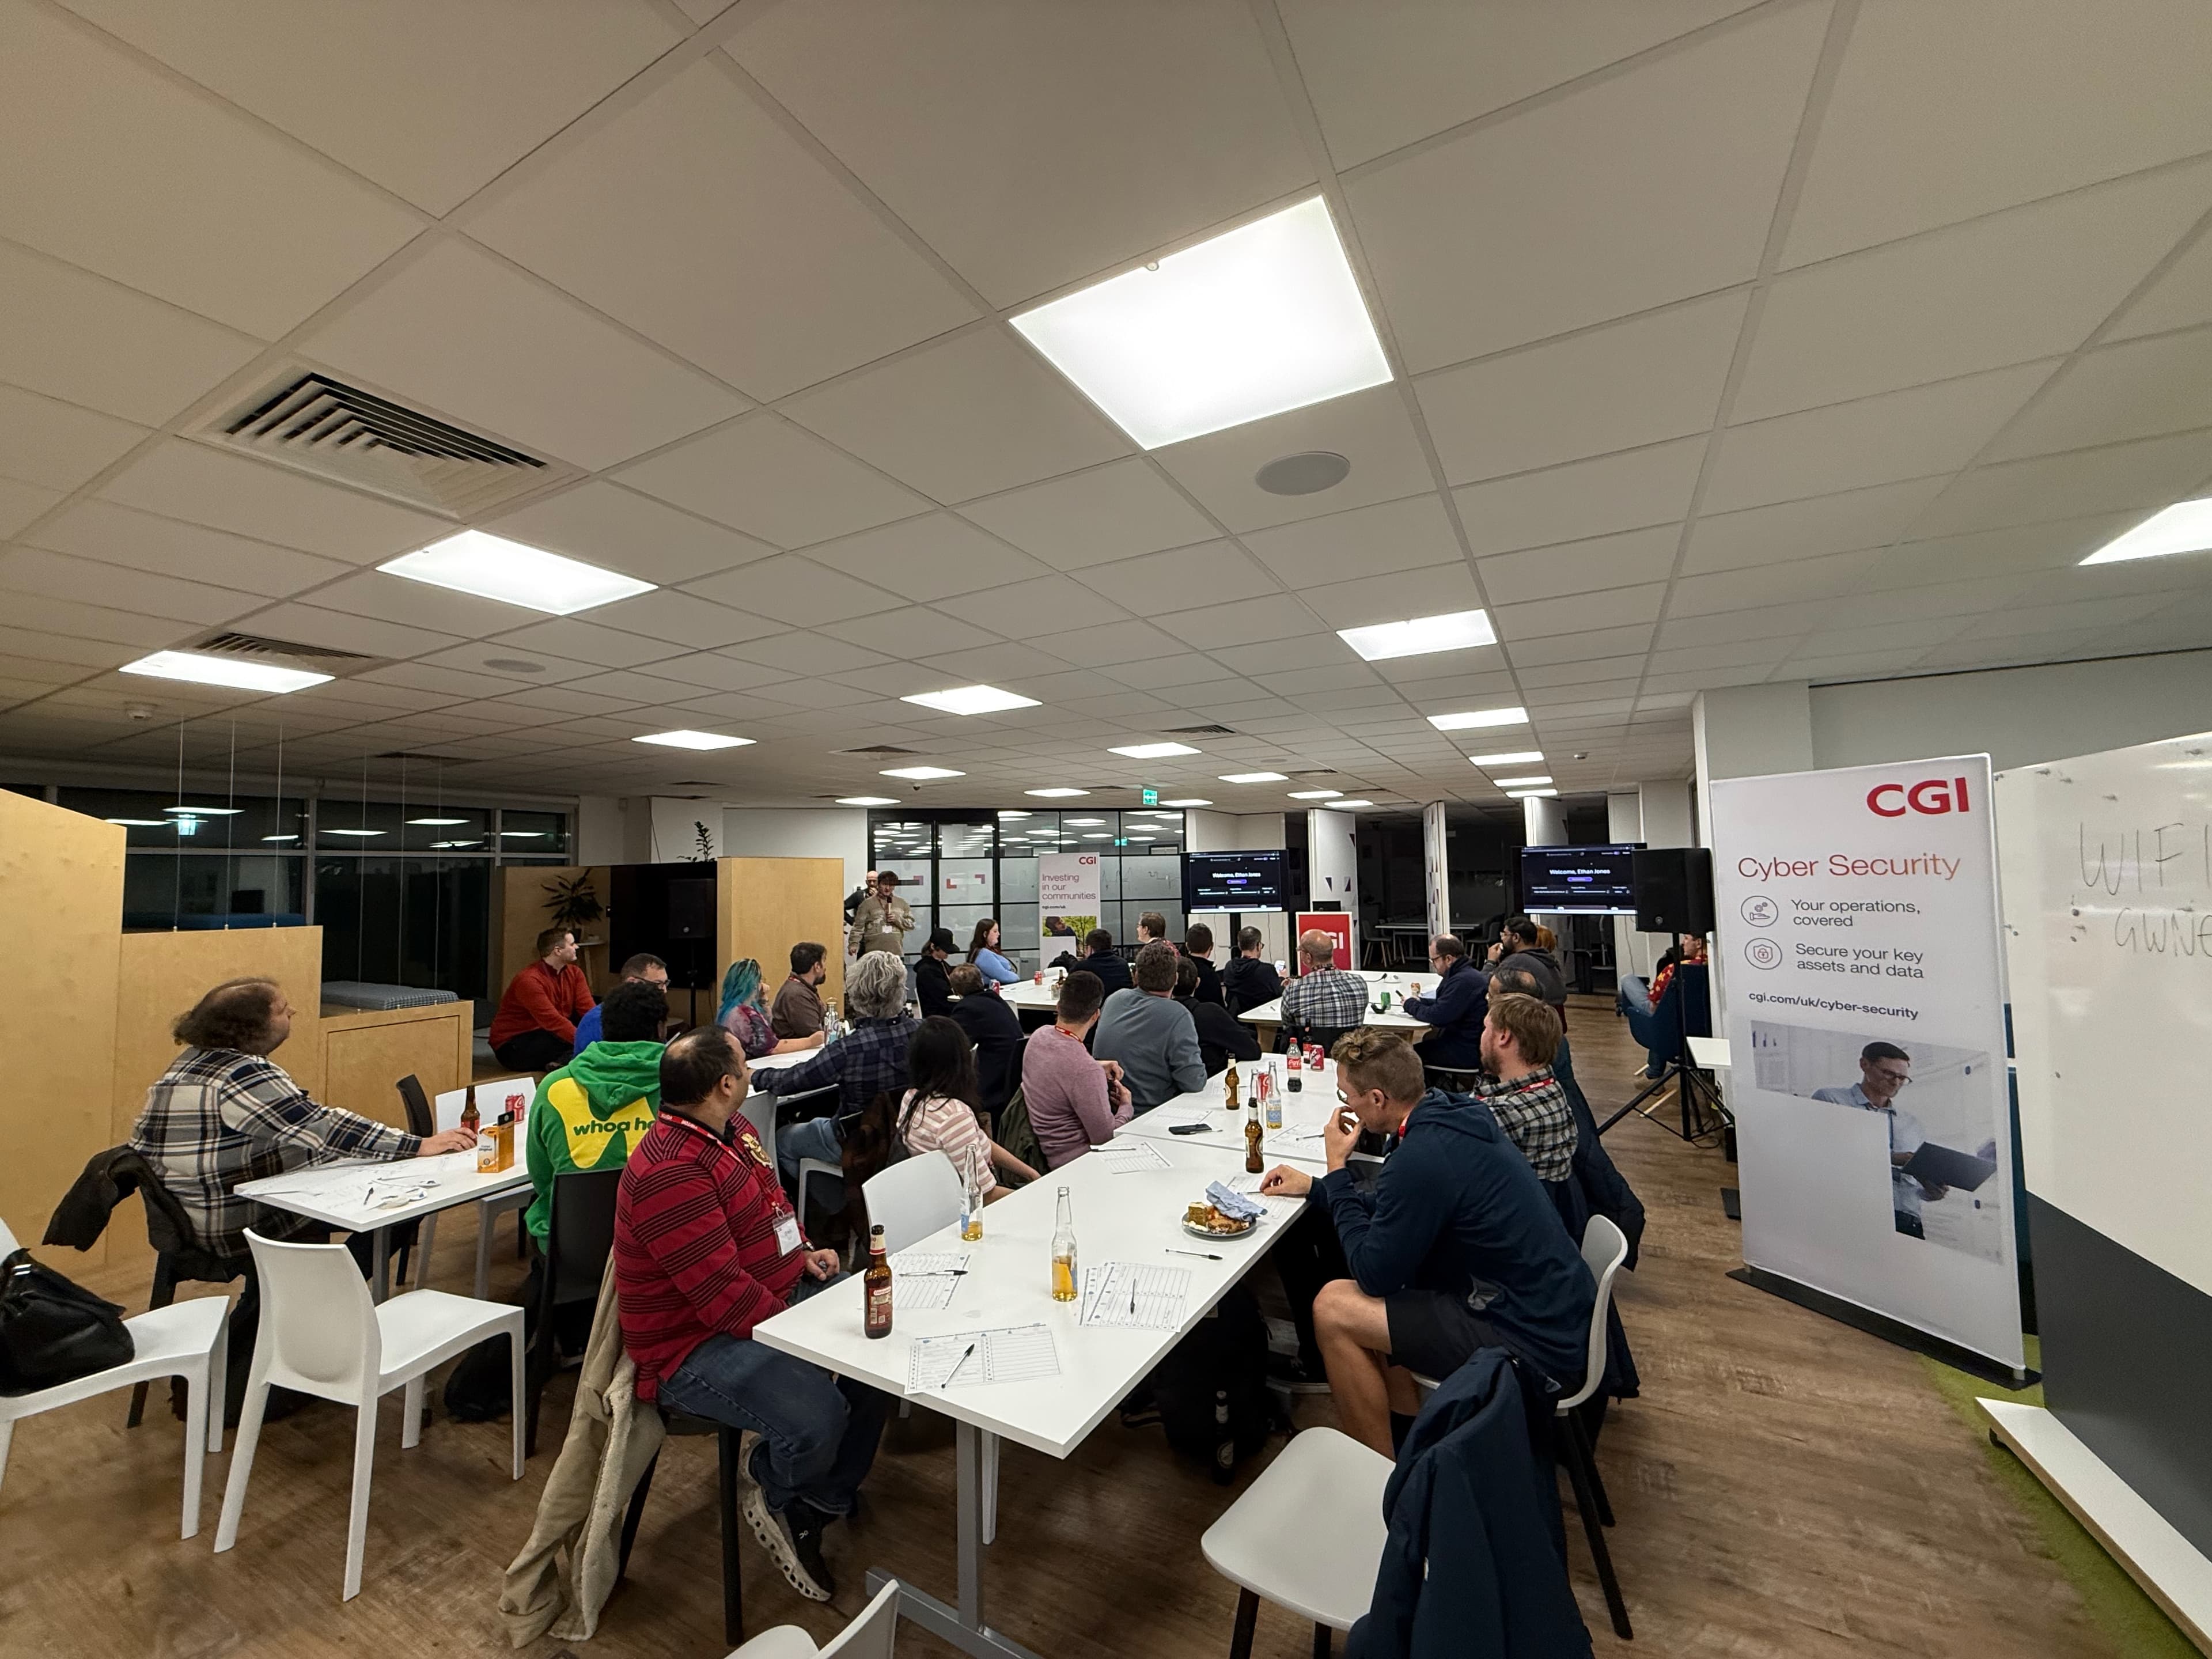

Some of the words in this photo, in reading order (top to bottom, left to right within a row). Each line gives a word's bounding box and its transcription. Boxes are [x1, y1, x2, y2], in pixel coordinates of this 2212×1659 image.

[1866, 777, 1970, 817] CGI
[1078, 856, 1097, 865] CGI
[1738, 857, 1819, 882] Cyber
[1828, 853, 1961, 881] Security
[2079, 822, 2211, 896] WIFI
[1041, 874, 1080, 883] Investing
[1041, 892, 1096, 900] communities
[1790, 899, 1825, 912] Your
[1830, 900, 1921, 914] operations,
[1793, 915, 1854, 927] covered
[1796, 943, 1849, 958] Secure
[1853, 948, 1889, 961] your
[1893, 948, 1923, 964] key
[1797, 959, 1846, 973] assets
[1850, 962, 1880, 976] and
[1885, 964, 1925, 979] data
[1748, 991, 1919, 1021] cgi.com/uk/cyber-security
[573, 1120, 631, 1136] whoa
